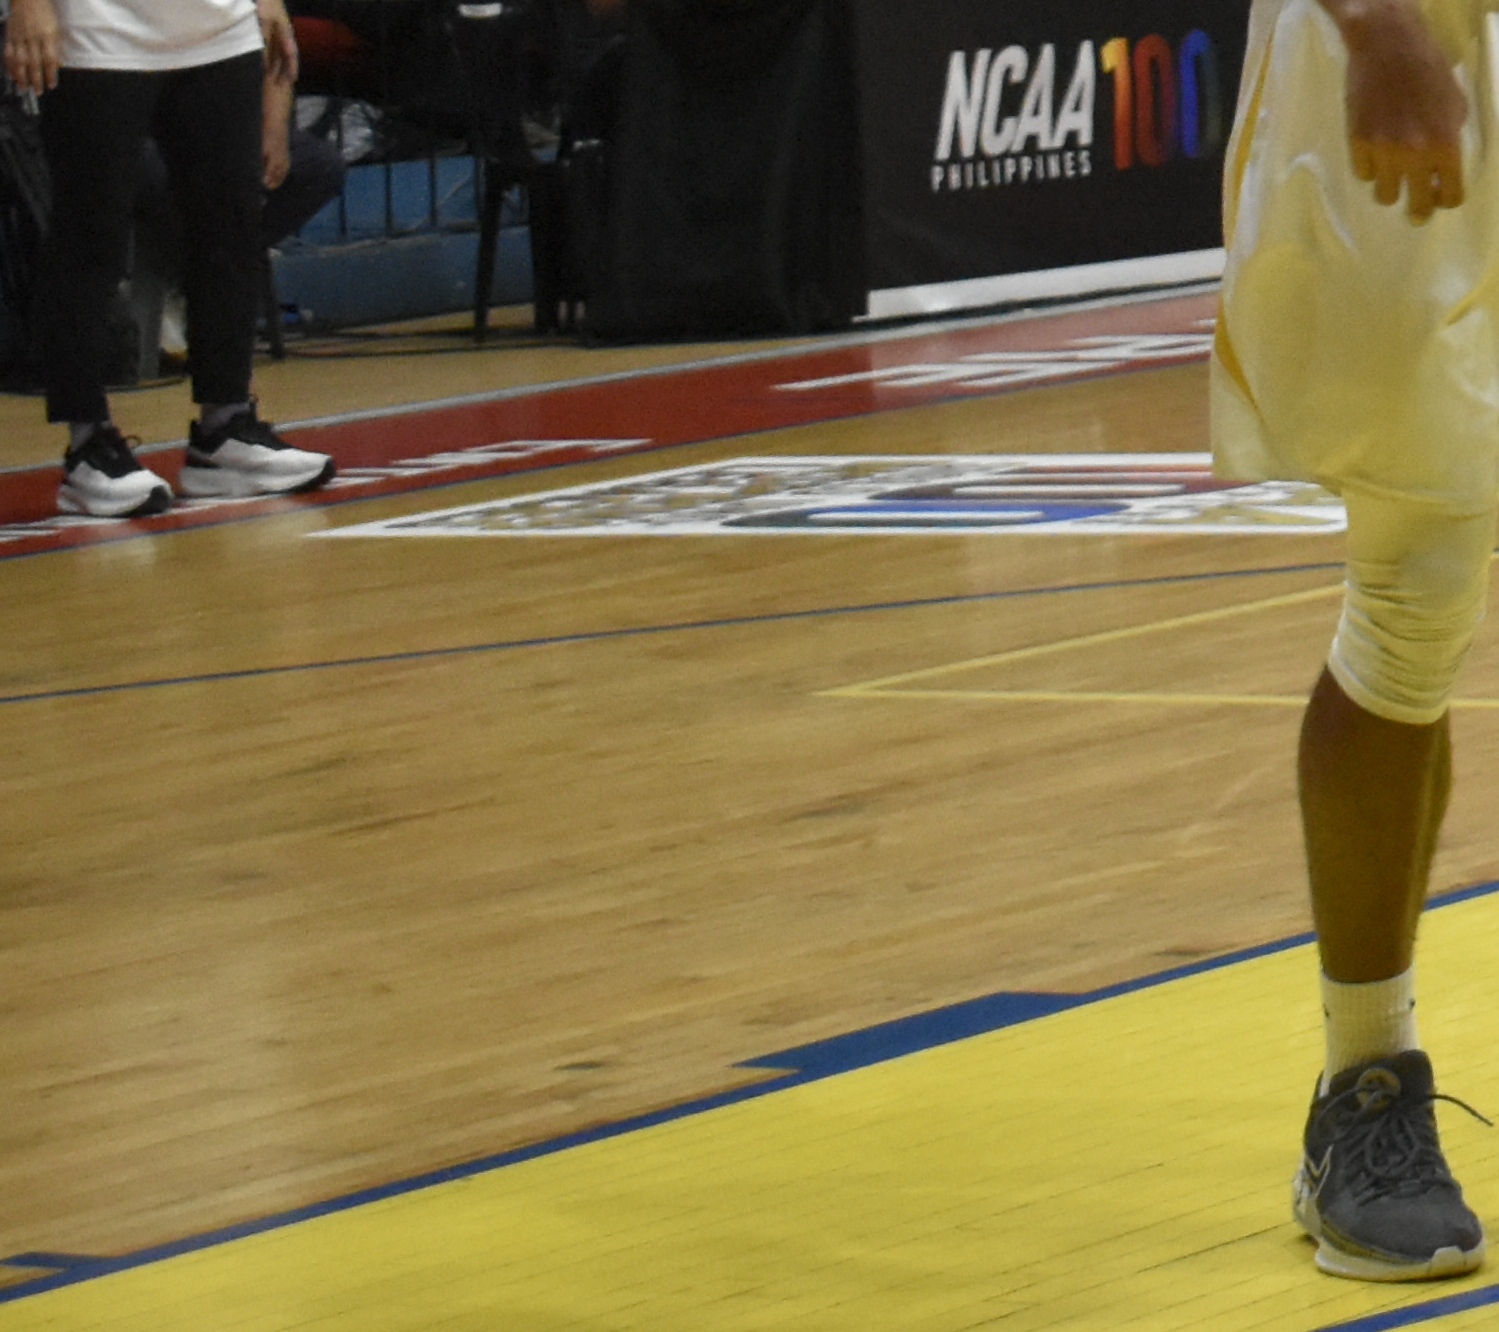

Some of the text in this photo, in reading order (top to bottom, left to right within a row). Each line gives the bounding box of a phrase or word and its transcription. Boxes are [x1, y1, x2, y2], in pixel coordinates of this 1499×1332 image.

[934, 29, 1225, 171] NCAA 100
[930, 149, 1094, 193] PHILIPPINES
